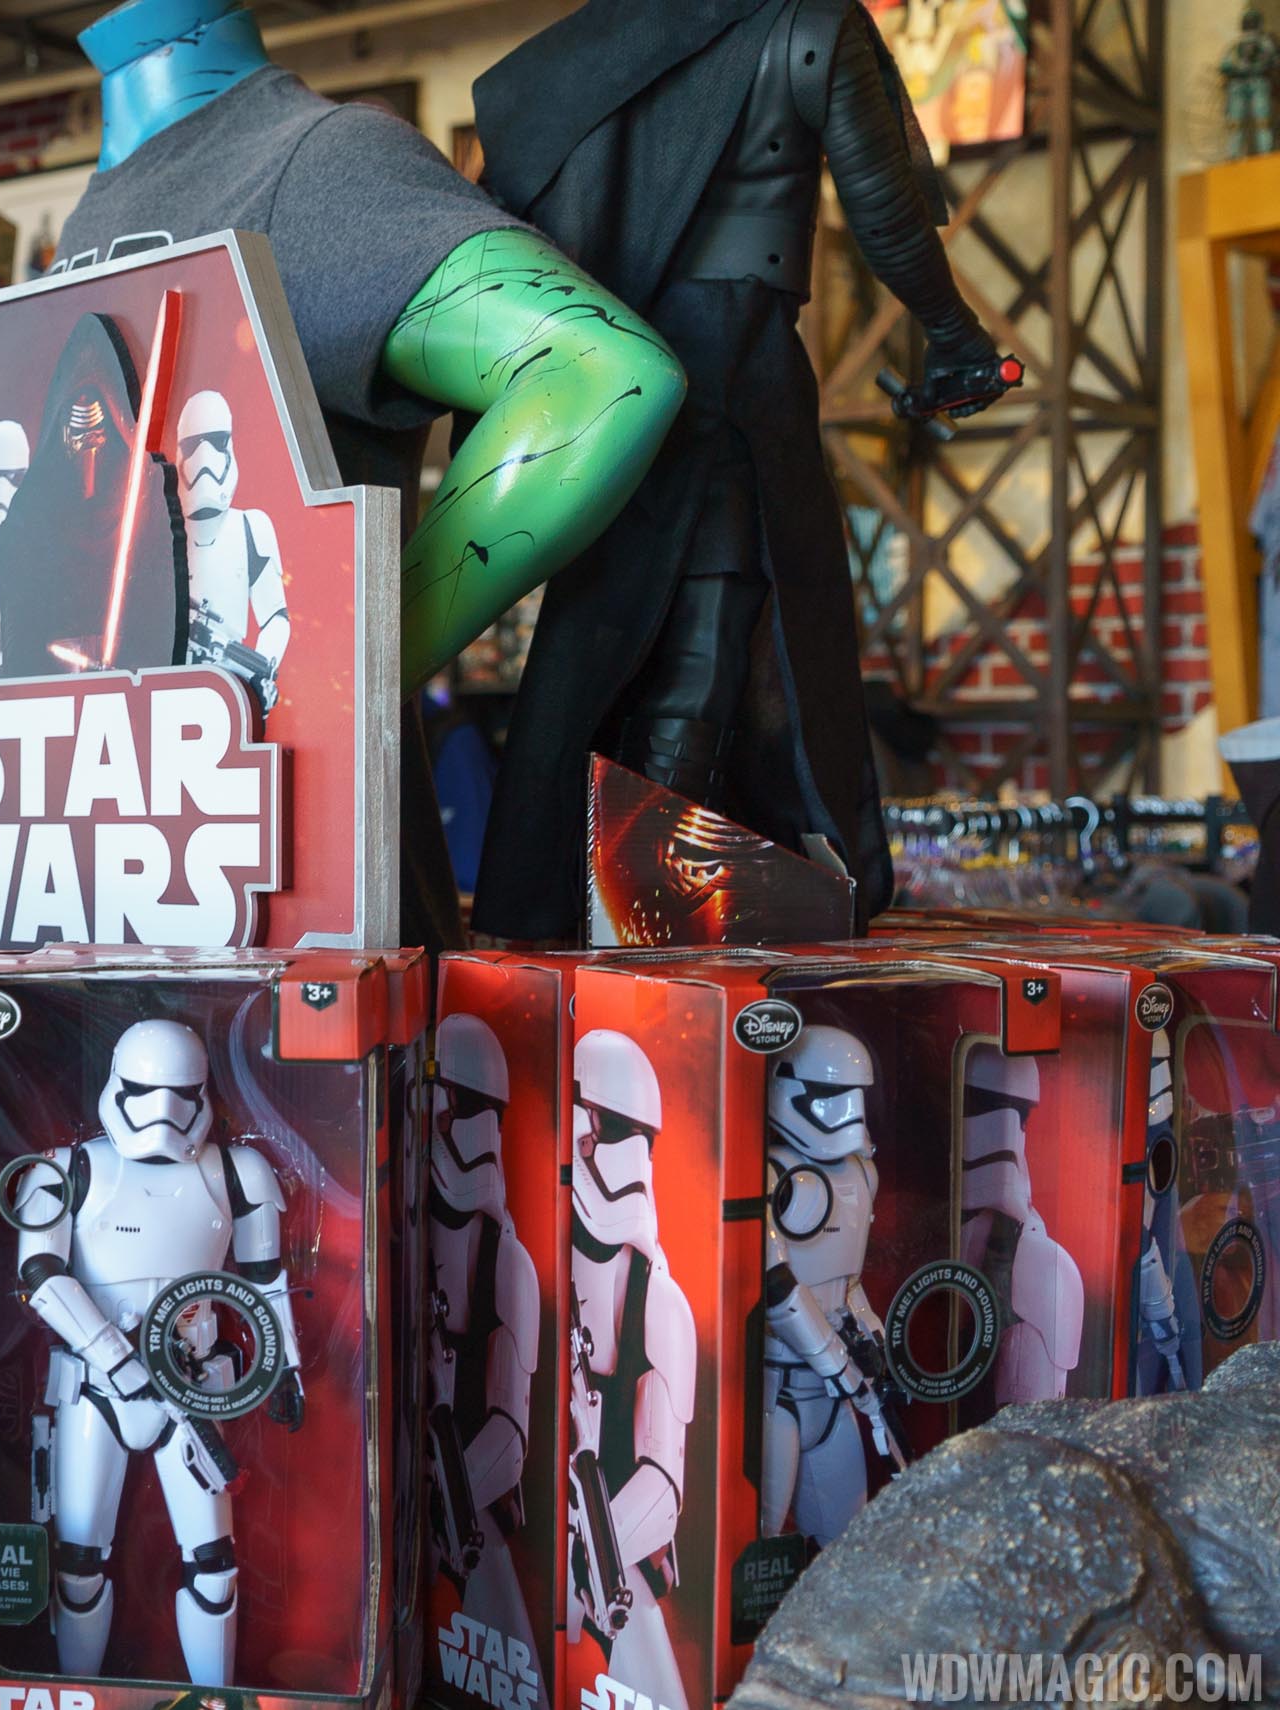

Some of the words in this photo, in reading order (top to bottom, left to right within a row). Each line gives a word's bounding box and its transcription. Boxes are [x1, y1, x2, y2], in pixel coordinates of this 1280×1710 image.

[307, 984, 332, 1001] 3+
[1027, 982, 1044, 996] 3+
[756, 1035, 781, 1044] STORE
[174, 1279, 223, 1300] LIGHTS
[226, 1283, 256, 1307] AND
[154, 1297, 175, 1324] ME!
[892, 1321, 902, 1348] TRY
[897, 1292, 914, 1318] ME!
[912, 1269, 952, 1293] LIGHTS
[954, 1270, 978, 1290] AND
[976, 1288, 994, 1348] SOUNDS!
[150, 1325, 161, 1353] TRY
[254, 1306, 276, 1373] SOUNDS!
[744, 1555, 794, 1582] REAL
[438, 1611, 537, 1687] STAR
[438, 1641, 537, 1710] WARS
